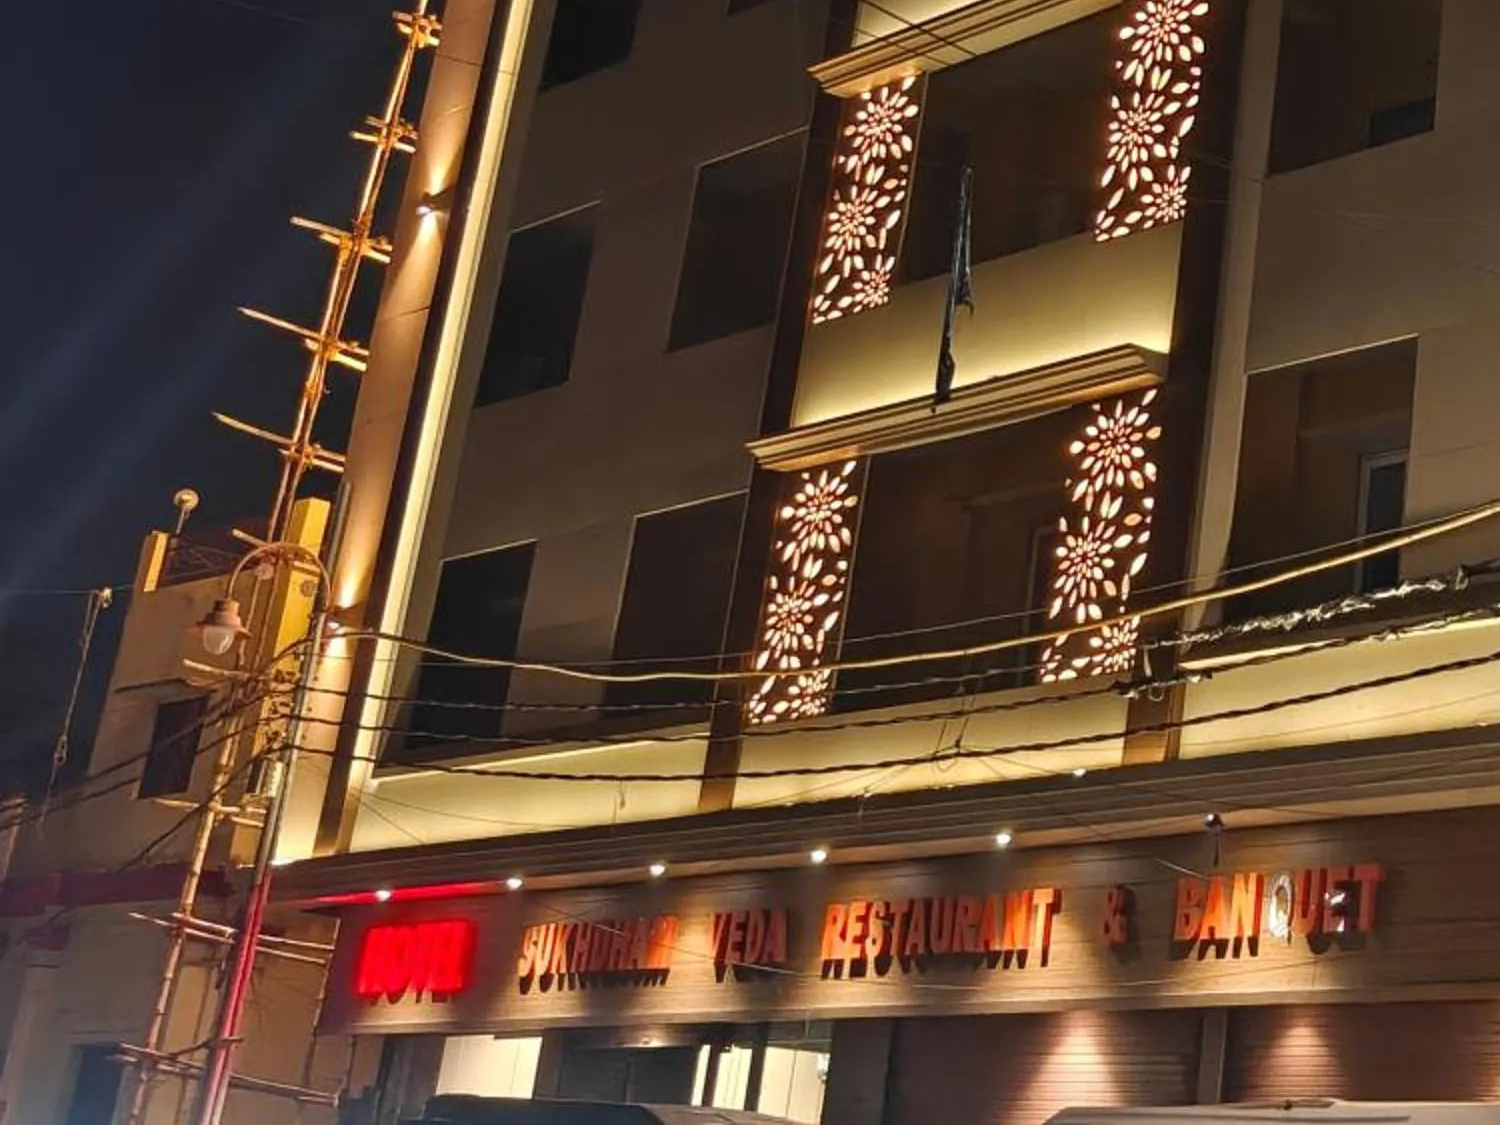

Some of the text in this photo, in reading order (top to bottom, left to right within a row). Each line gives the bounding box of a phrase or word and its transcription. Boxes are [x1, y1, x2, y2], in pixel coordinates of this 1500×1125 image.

[707, 908, 792, 965] VEDA
[820, 887, 1061, 961] RESTAURANT
[1101, 885, 1129, 943] &
[1173, 863, 1386, 947] BANQUET
